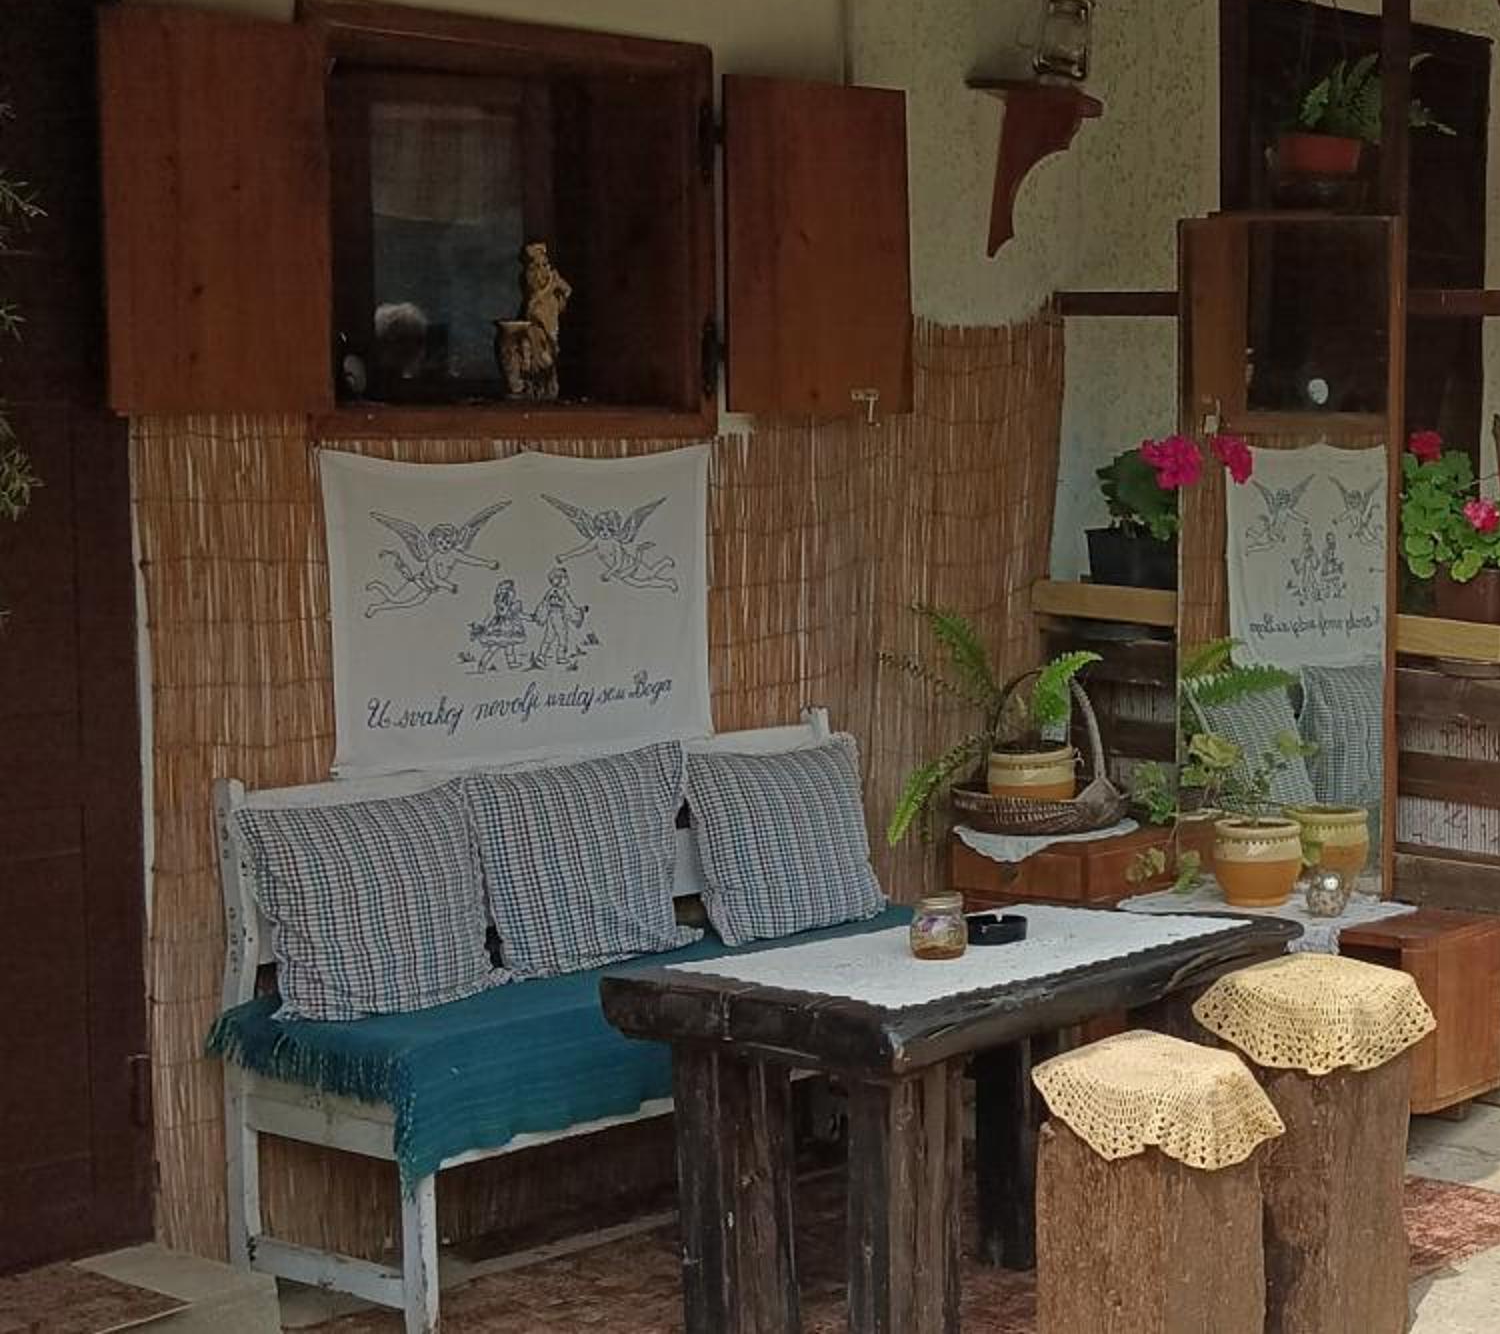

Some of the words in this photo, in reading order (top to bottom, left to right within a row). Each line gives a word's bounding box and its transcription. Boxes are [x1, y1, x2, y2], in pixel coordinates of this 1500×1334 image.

[368, 697, 391, 728] U
[396, 694, 464, 735] svakoj
[628, 670, 673, 706] Boga
